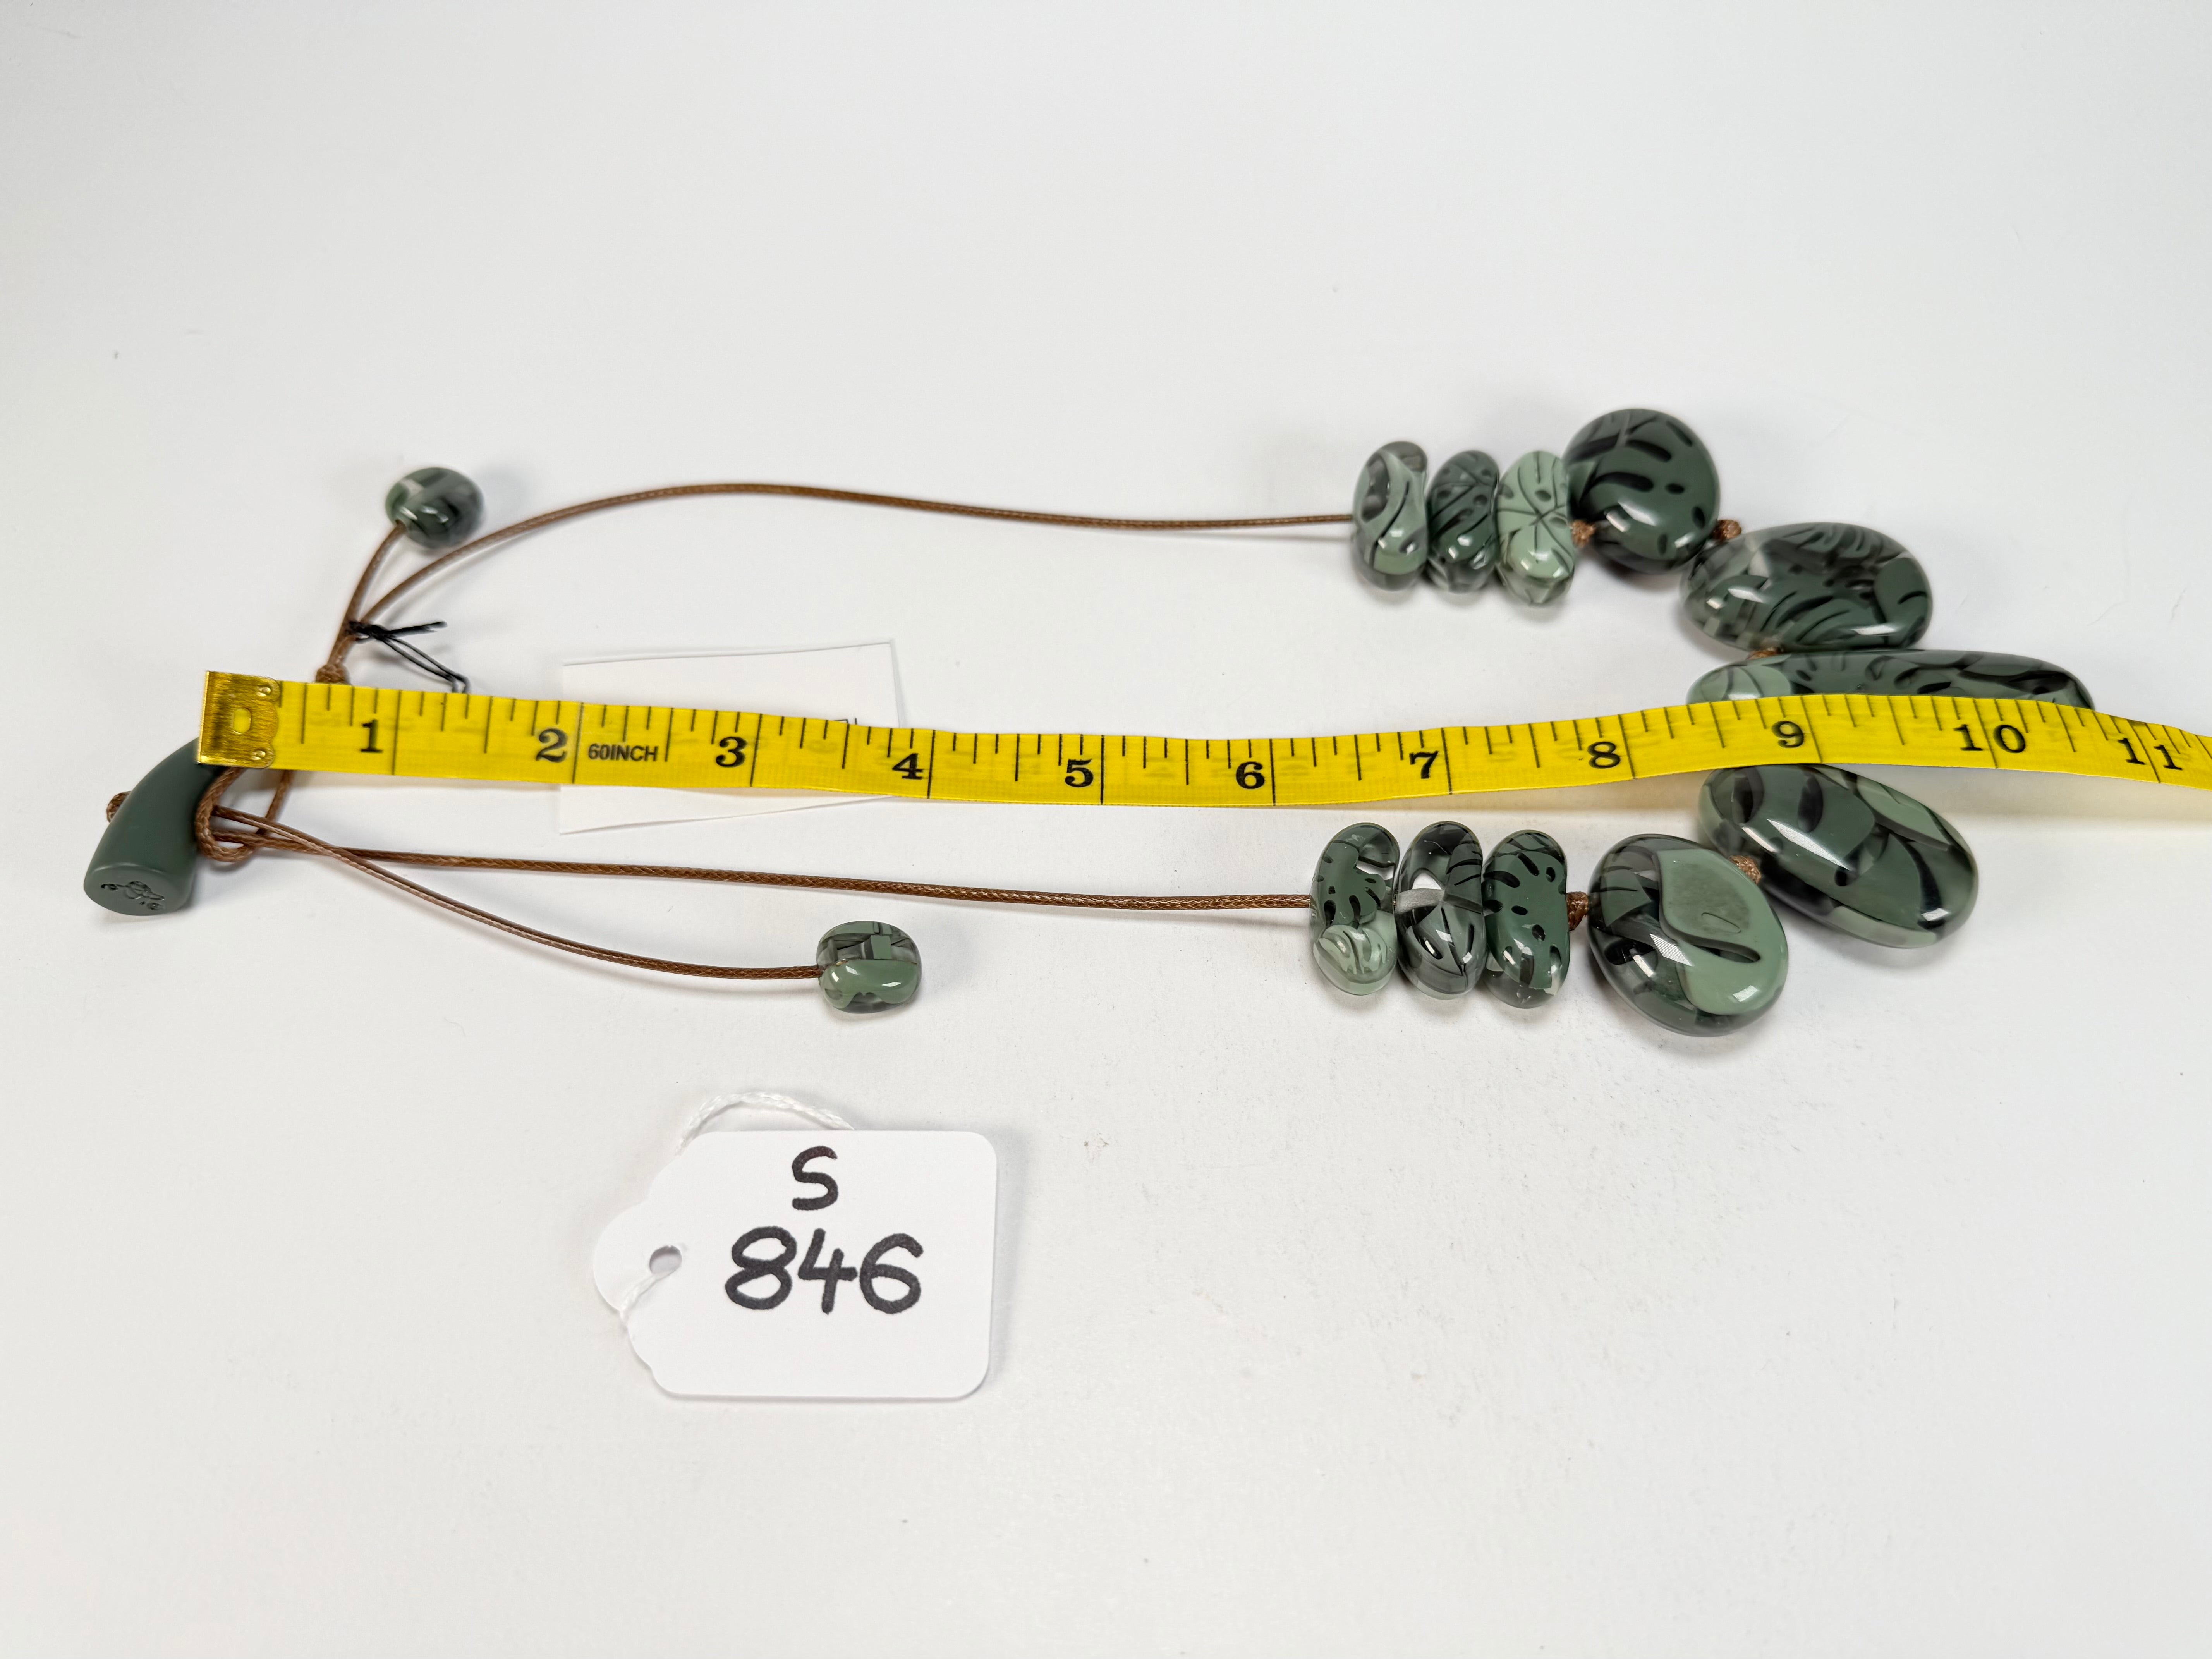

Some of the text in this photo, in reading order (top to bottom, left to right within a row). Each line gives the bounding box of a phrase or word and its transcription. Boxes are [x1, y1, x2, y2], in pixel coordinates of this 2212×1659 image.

[361, 719, 383, 754] 1
[535, 727, 568, 762] 2
[715, 736, 747, 767] 3
[892, 752, 924, 780] 4
[1064, 759, 1094, 788] 5
[1235, 761, 1265, 789] 6
[1409, 750, 1439, 779] 7
[1587, 741, 1621, 769] 8
[1771, 720, 1805, 748] 9
[792, 1145, 838, 1211] S
[725, 1225, 924, 1315] 846
